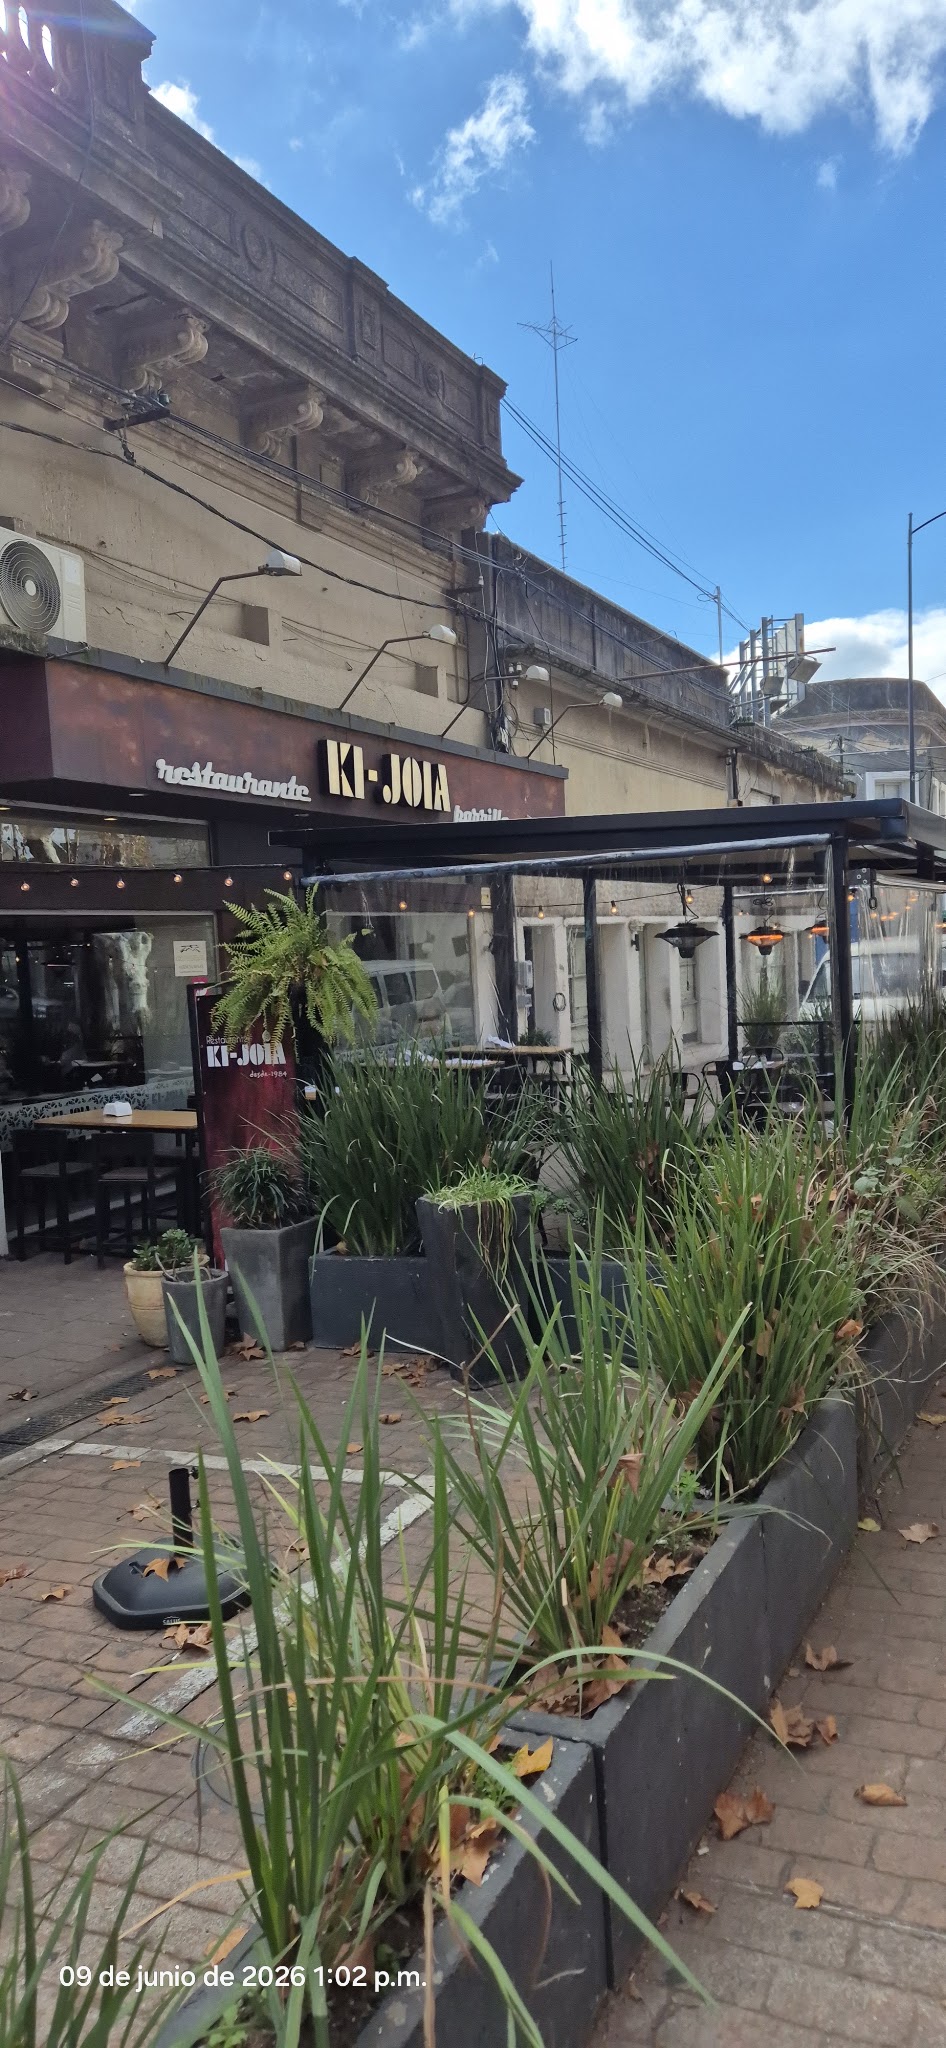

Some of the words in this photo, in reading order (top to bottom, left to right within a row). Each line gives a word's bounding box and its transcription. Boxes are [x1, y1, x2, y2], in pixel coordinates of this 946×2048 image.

[156, 758, 312, 802] restaurante
[454, 805, 509, 823] parrill
[206, 1043, 286, 1068] KI-JOIA
